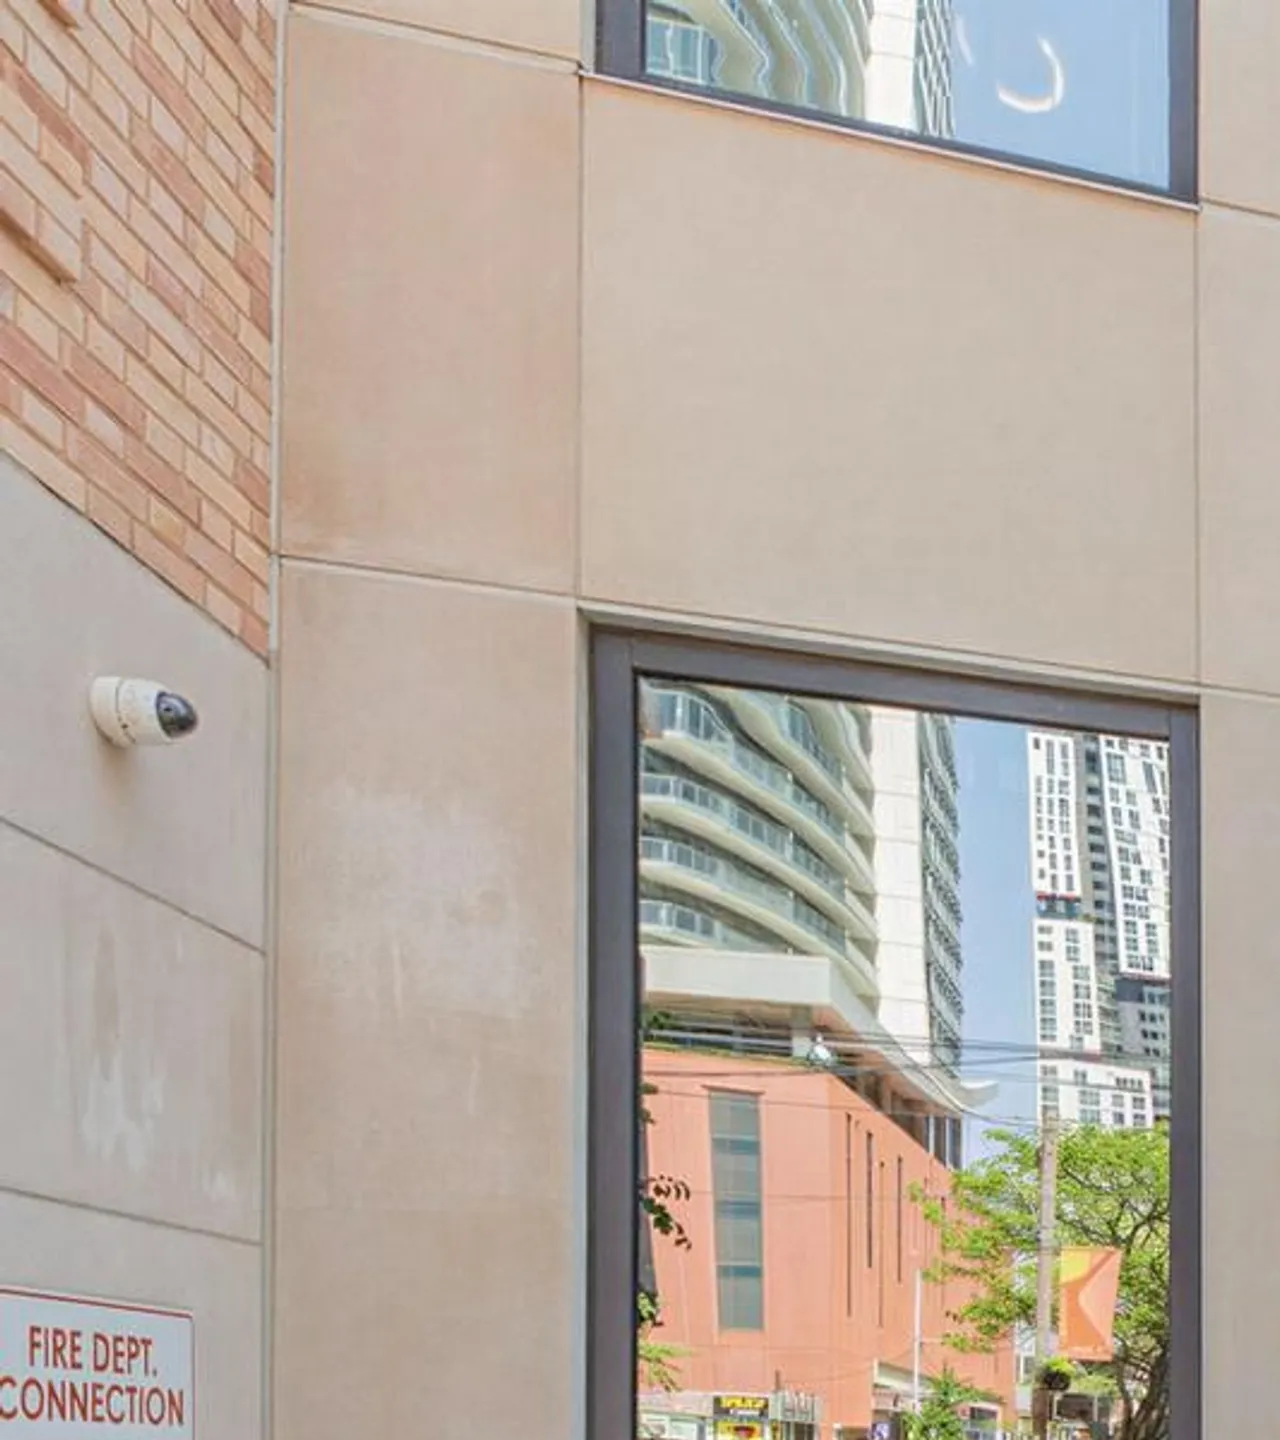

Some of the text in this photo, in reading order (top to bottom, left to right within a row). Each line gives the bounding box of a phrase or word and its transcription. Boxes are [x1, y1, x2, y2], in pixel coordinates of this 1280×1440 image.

[29, 1325, 157, 1377] FIRE DEPT.
[0, 1375, 184, 1426] CONNECTION
